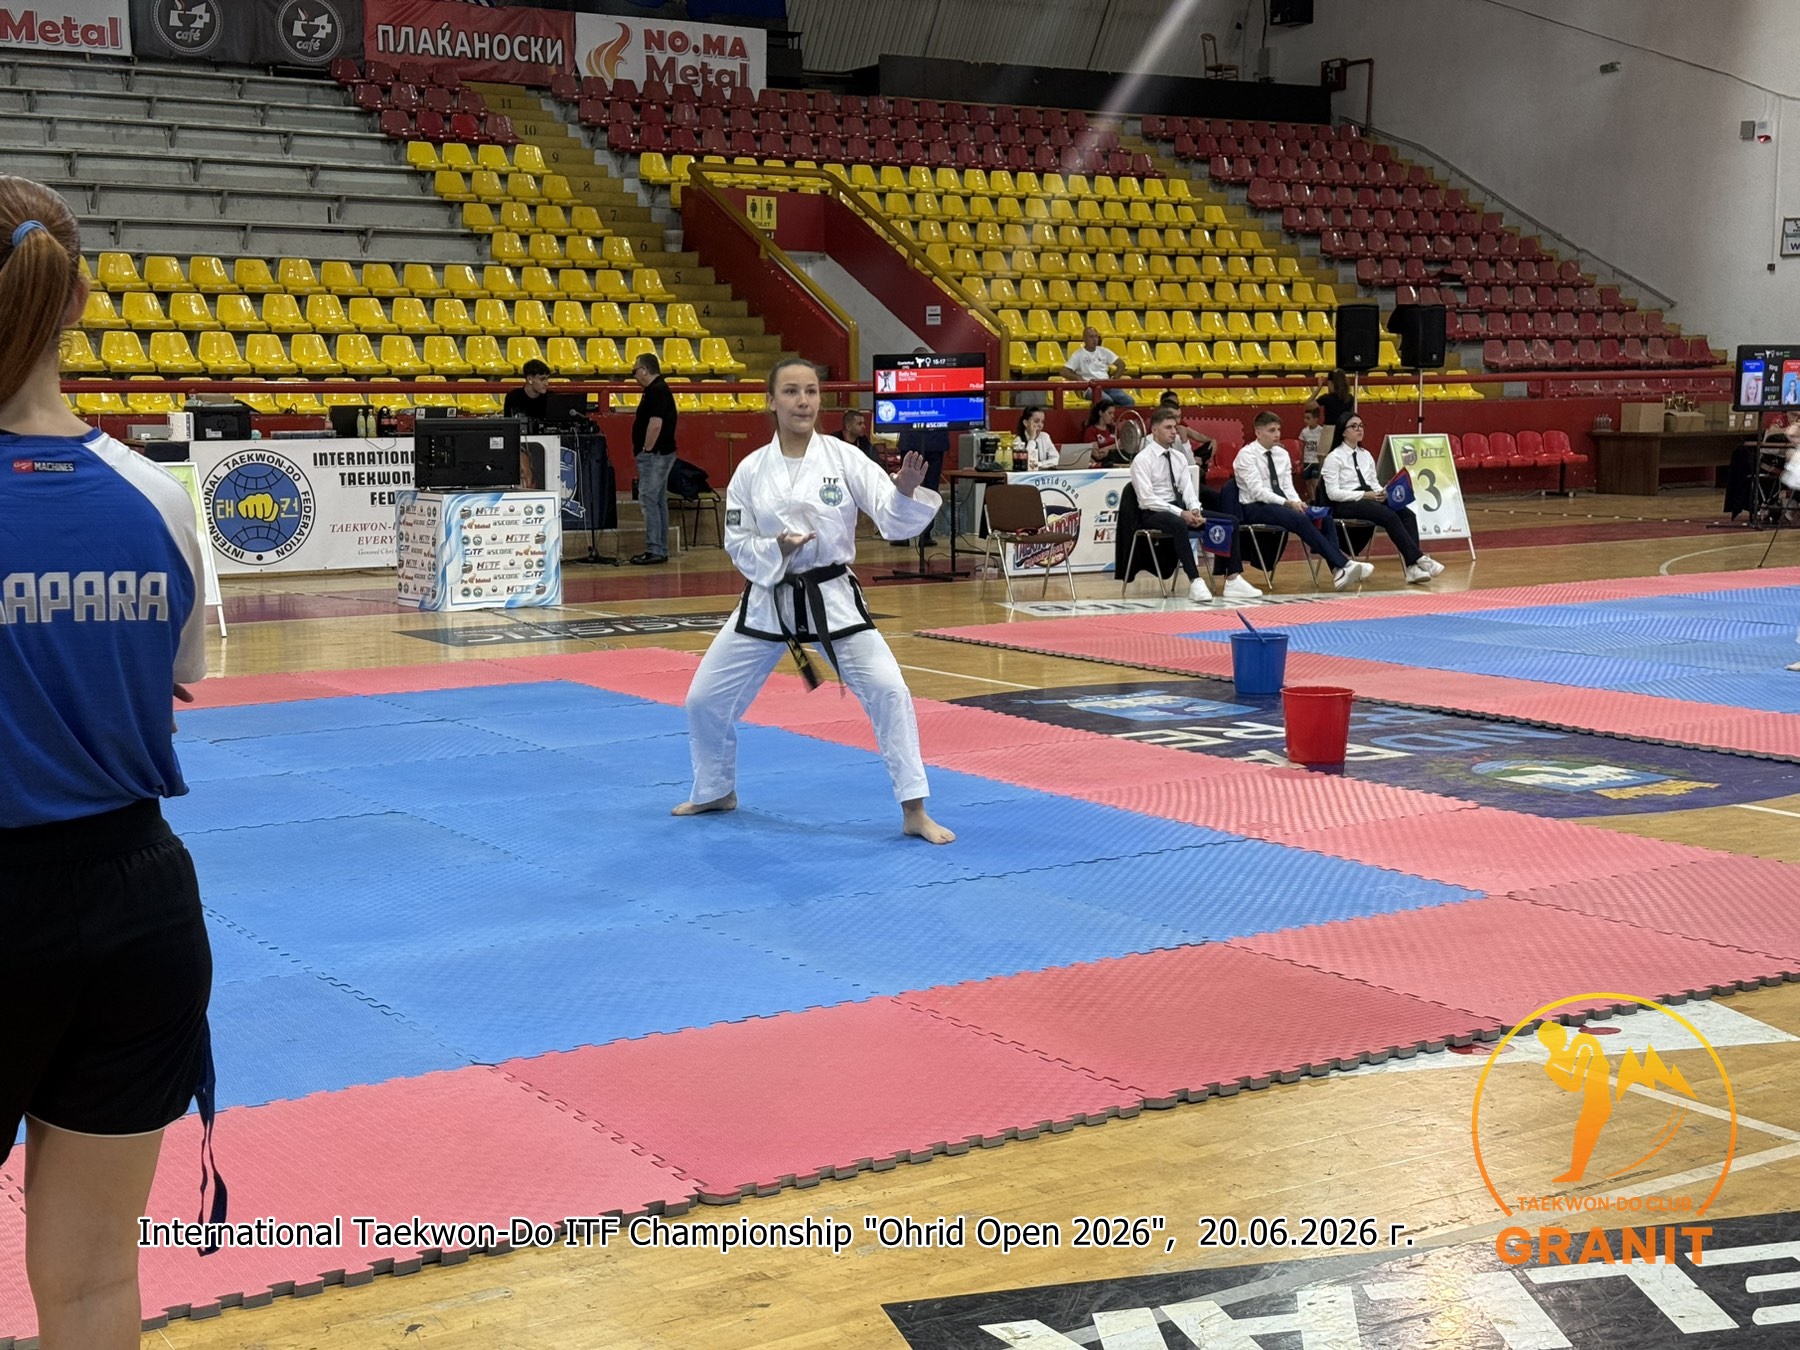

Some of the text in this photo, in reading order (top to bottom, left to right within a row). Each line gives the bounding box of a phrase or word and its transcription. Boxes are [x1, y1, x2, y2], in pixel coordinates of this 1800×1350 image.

[0, 9, 121, 48] Metal
[175, 28, 201, 43] café
[296, 39, 321, 53] café
[376, 22, 563, 66] ПЛАЌАНОСКИ
[645, 54, 749, 89] Metal
[524, 124, 537, 136] 10
[551, 151, 559, 163] 9
[583, 181, 591, 192] 8
[610, 209, 617, 221] 7
[640, 239, 648, 251] 6
[674, 271, 682, 283] 5
[703, 304, 711, 317] 4
[737, 338, 745, 350] 3
[1770, 373, 1776, 383] 4
[34, 462, 74, 472] MACHINES
[823, 477, 840, 485] ITF
[1035, 477, 1079, 500] Ohrid Open
[1417, 468, 1442, 512] 3
[223, 453, 302, 482] TAEKWON-DO
[275, 490, 312, 558] FEDERATION
[0, 571, 169, 625] APARA
